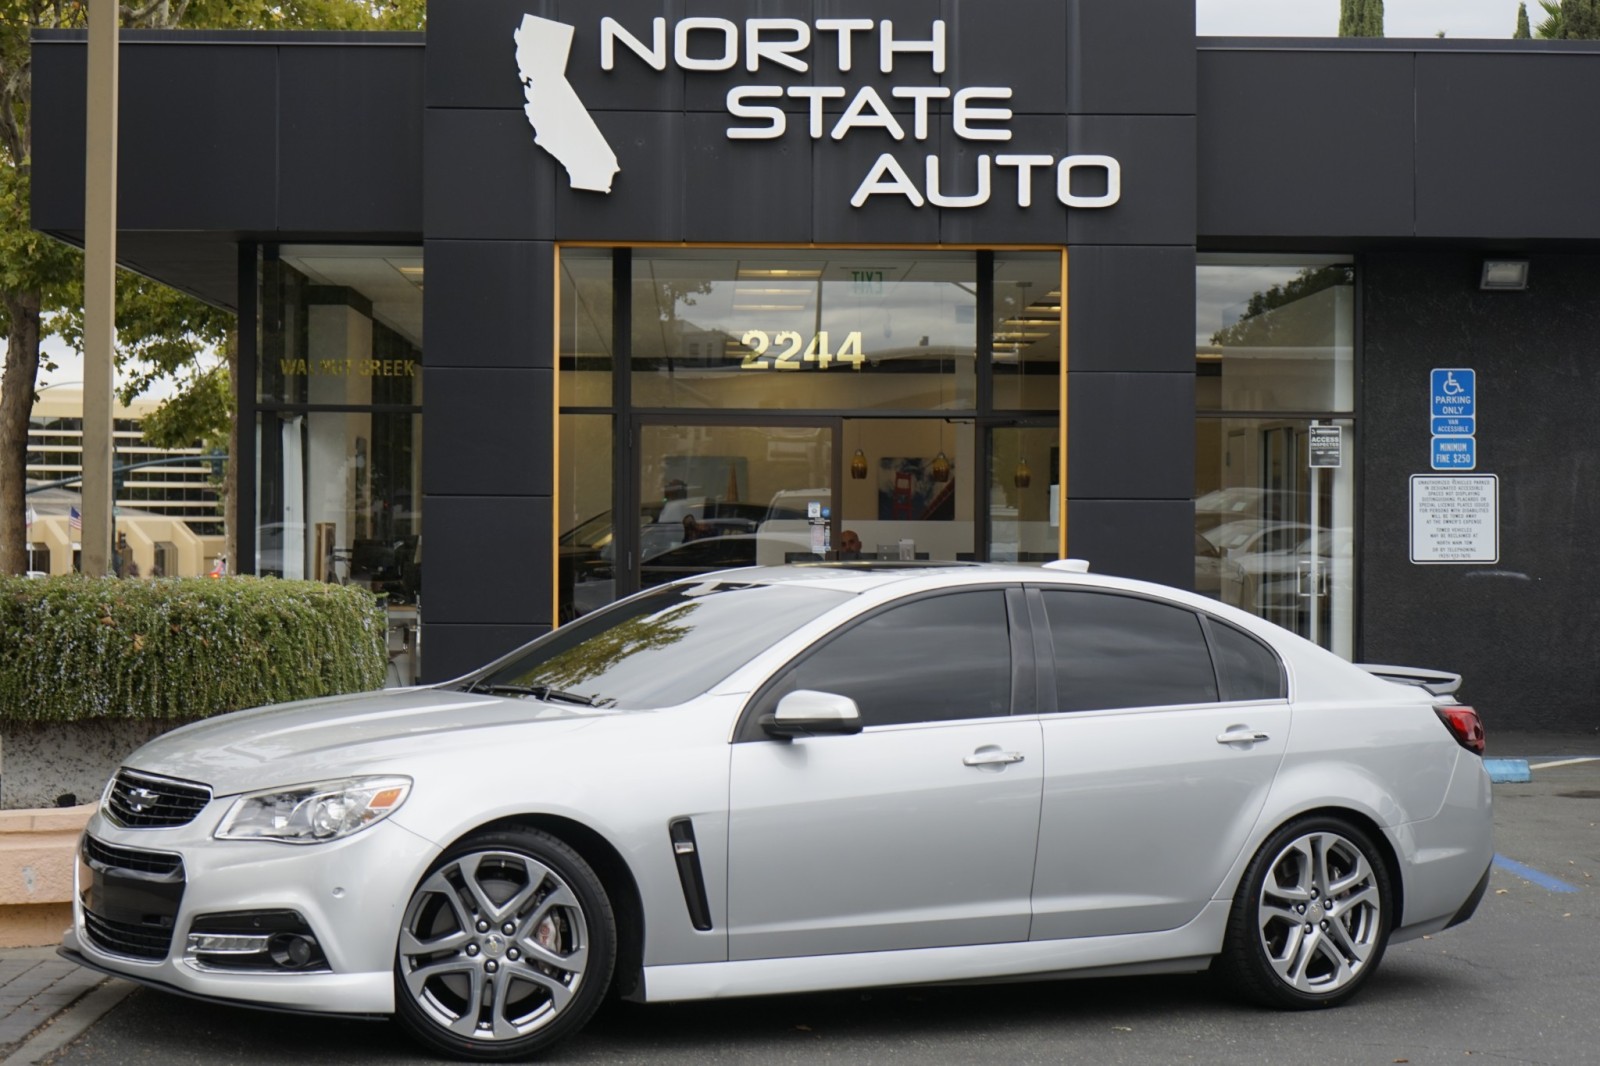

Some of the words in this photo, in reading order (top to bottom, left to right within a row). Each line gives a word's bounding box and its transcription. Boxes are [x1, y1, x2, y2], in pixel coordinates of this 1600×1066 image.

[601, 16, 946, 73] NORTH
[726, 86, 1013, 140] STATE
[850, 153, 1121, 208] AUTO
[741, 329, 865, 370] 2244
[360, 359, 414, 376] CREEK
[1435, 396, 1471, 404] PARKING
[1442, 406, 1464, 414] ONLY
[1440, 443, 1467, 451] MINIMUM
[1436, 454, 1450, 463] FINE
[1454, 454, 1470, 463] $250
